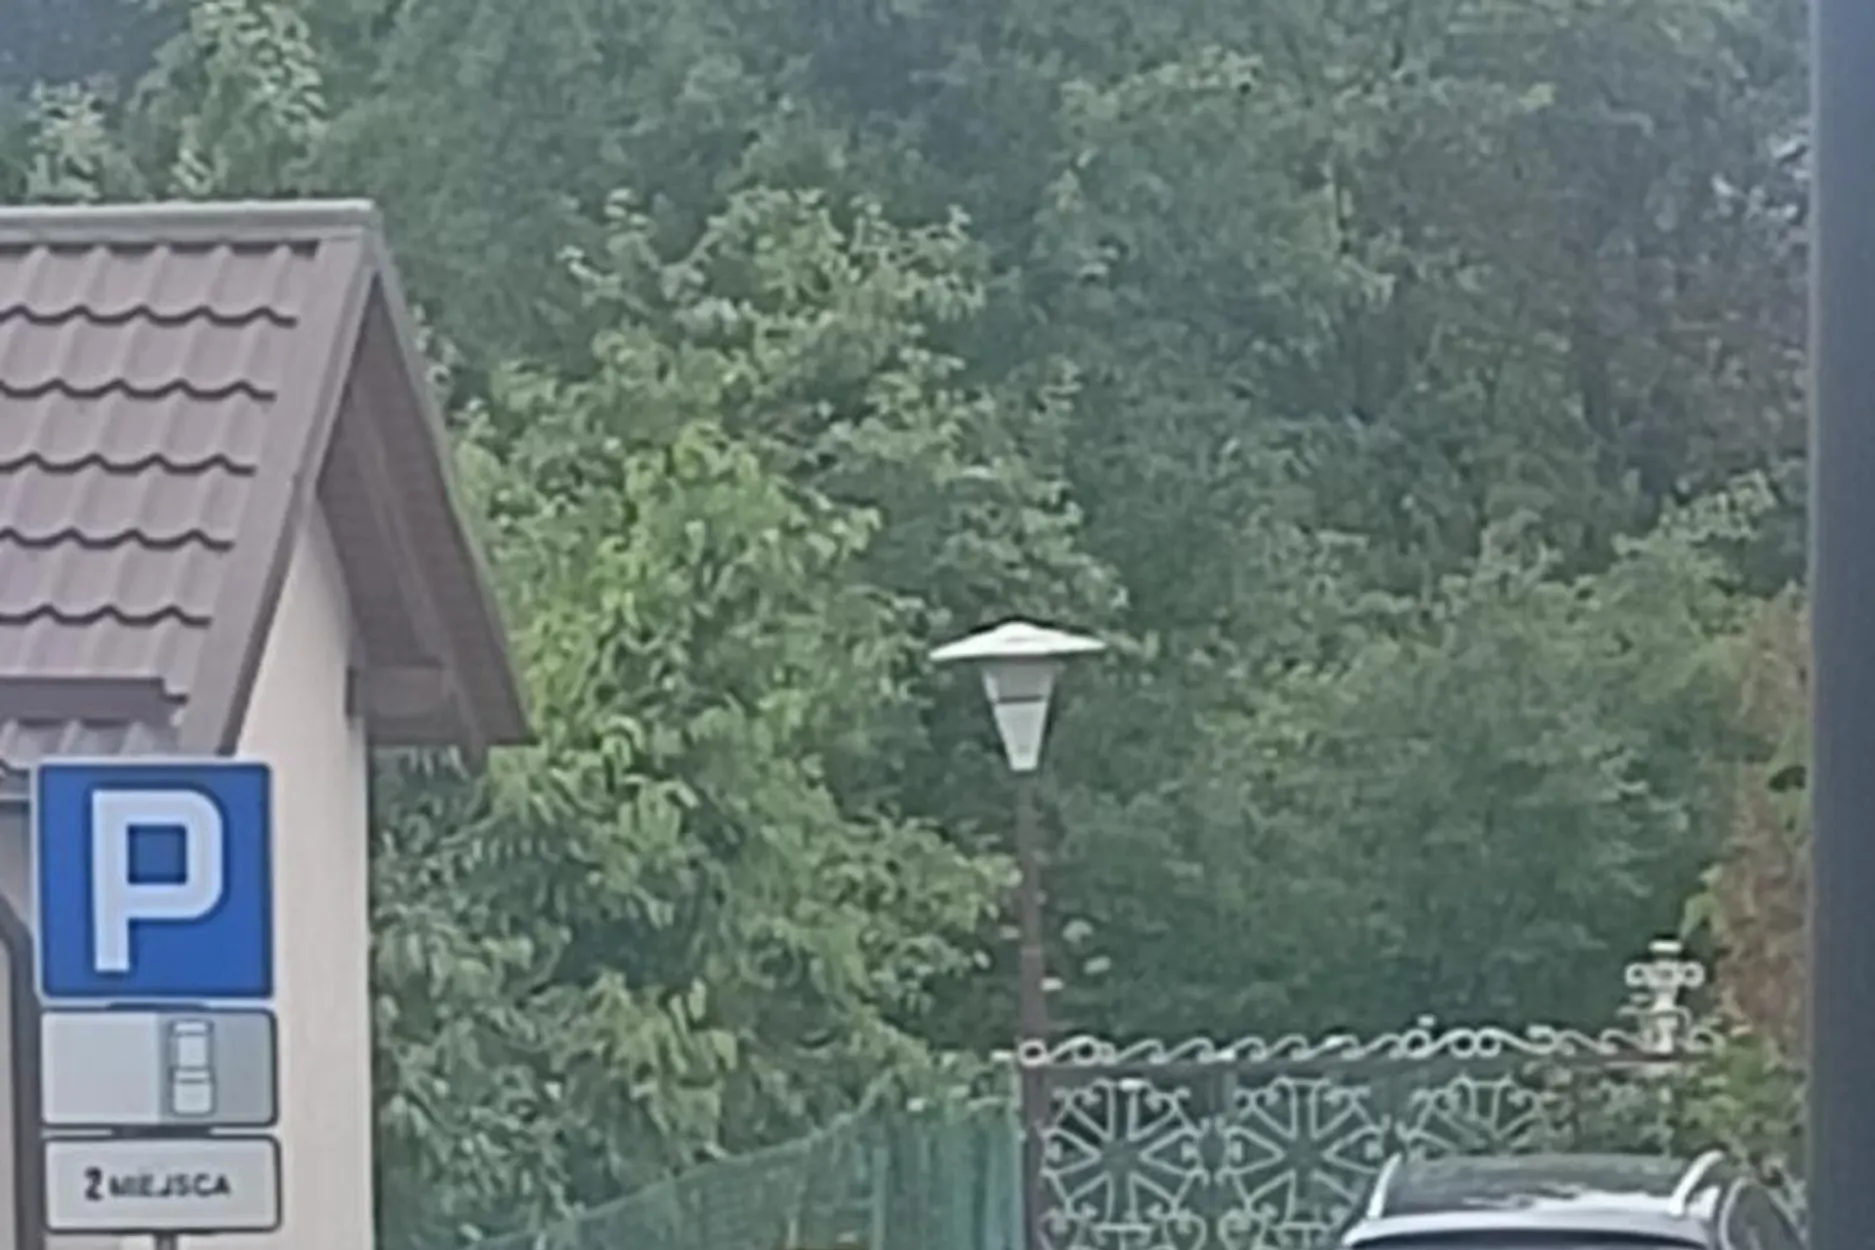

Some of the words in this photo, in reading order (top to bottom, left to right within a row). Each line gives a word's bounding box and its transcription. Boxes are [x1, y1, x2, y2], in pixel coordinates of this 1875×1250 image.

[92, 789, 224, 972] P
[84, 1166, 104, 1201] 2
[109, 1173, 231, 1198] MIEJSCA
